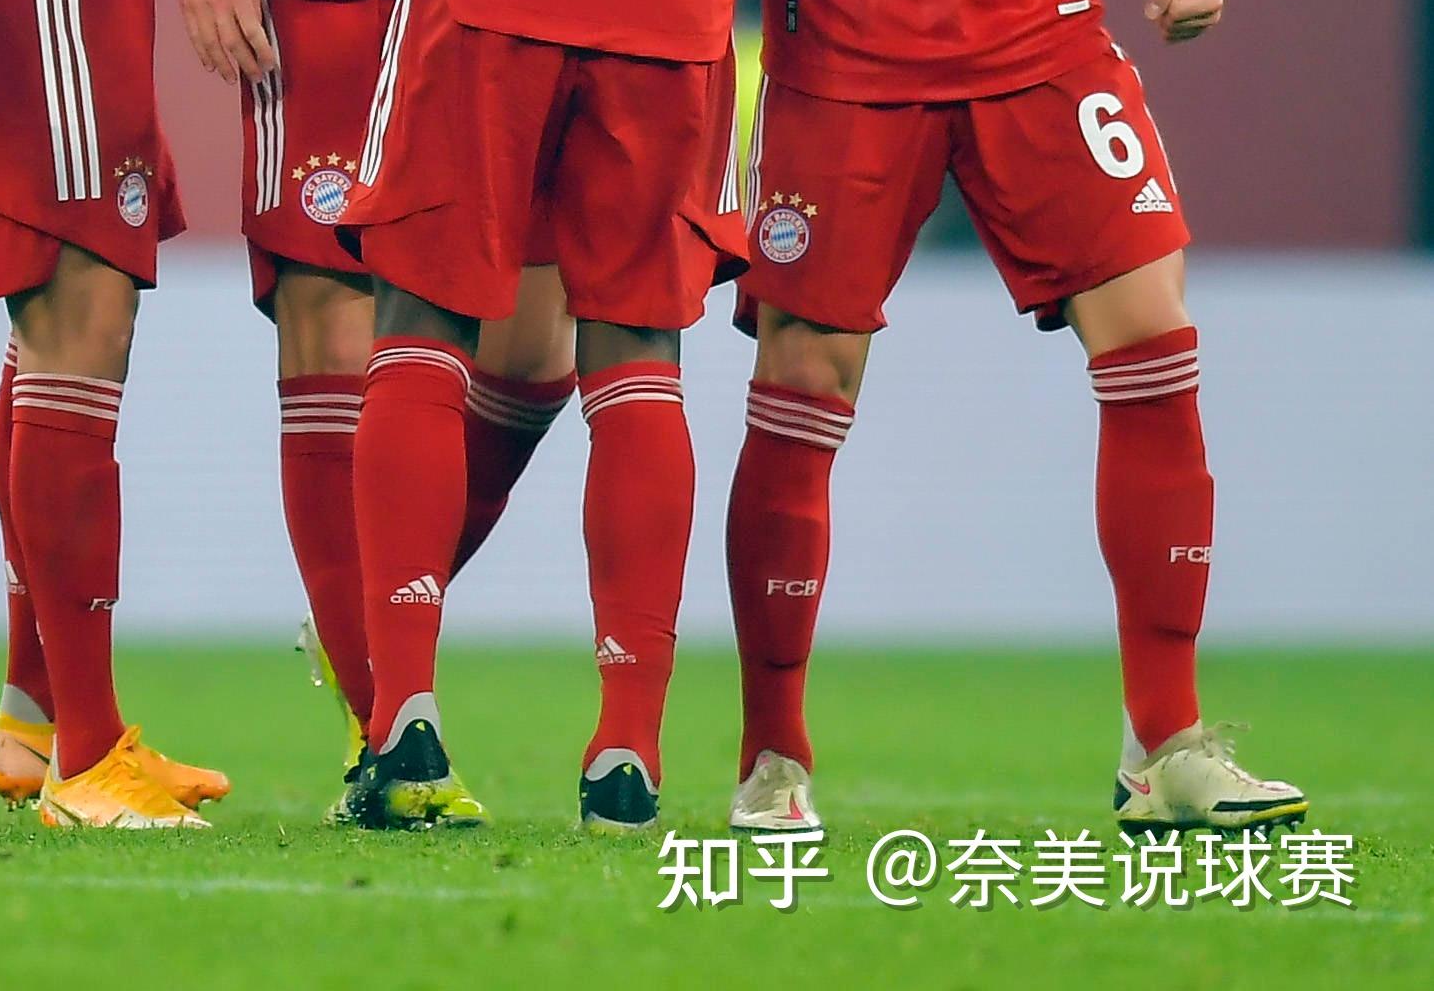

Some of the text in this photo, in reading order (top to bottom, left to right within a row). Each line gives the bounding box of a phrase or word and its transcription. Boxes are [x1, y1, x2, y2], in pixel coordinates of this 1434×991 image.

[1077, 92, 1145, 180] 6
[767, 579, 819, 596] FCB
[390, 592, 442, 605] adida
